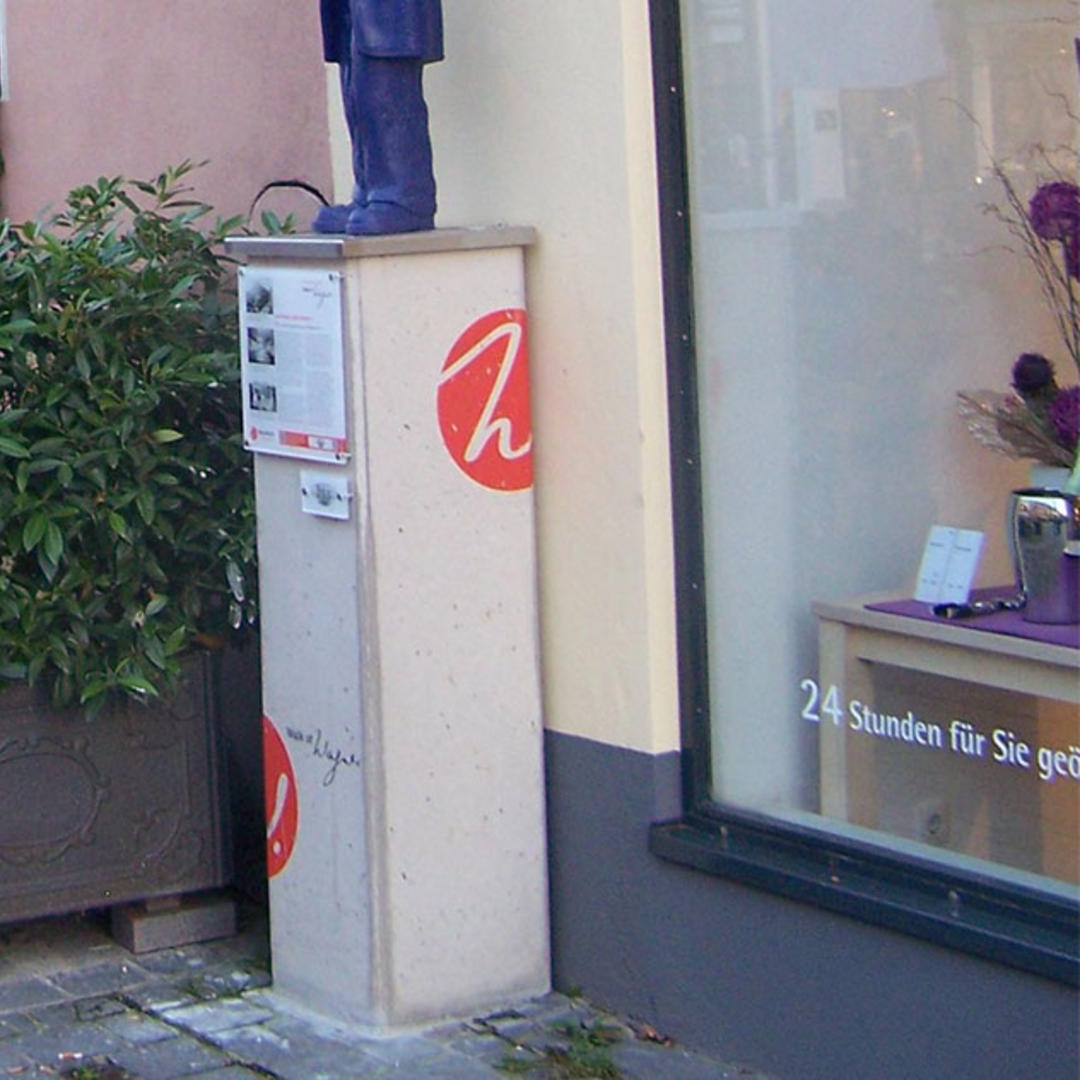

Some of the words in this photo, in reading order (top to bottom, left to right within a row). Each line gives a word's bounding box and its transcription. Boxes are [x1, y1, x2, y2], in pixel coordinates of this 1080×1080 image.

[800, 678, 844, 726] 24
[849, 699, 943, 749] Stunden
[948, 720, 987, 757] für
[992, 728, 1030, 768] Sie
